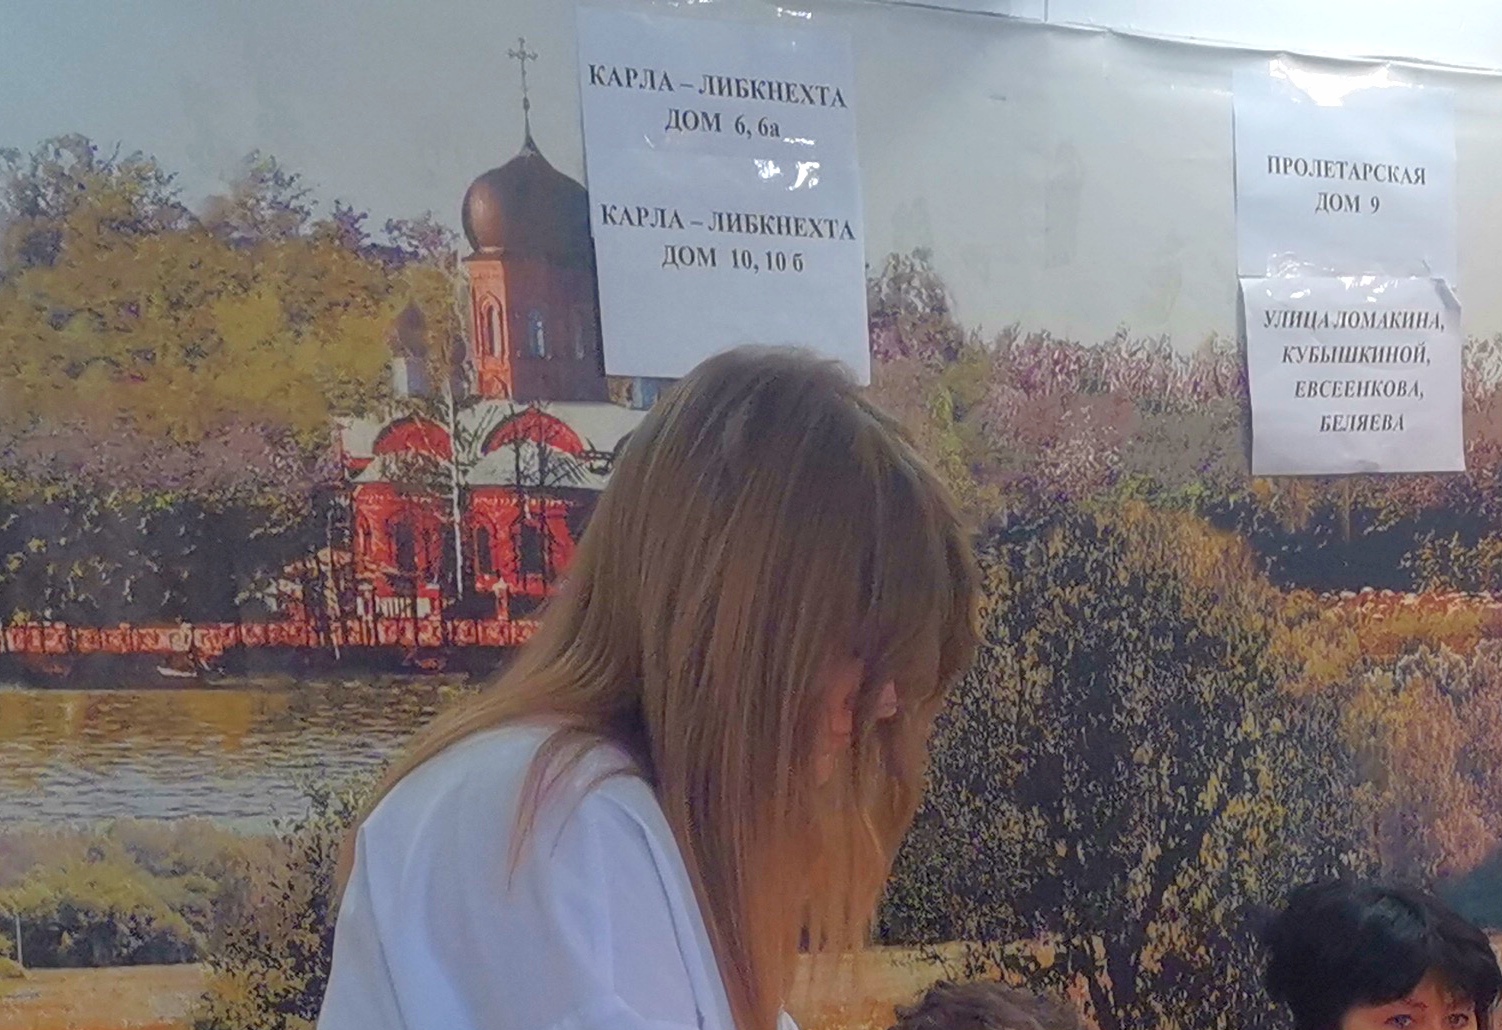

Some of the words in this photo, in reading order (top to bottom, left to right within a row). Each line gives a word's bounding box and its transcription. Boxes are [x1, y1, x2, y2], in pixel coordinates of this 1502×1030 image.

[588, 63, 675, 93] КАРЛА
[698, 74, 849, 109] ЛИБКНЕХТА
[665, 108, 722, 134] ДОМ
[734, 115, 753, 139] 6,
[757, 117, 781, 138] 6а
[1267, 155, 1426, 185] ПРОЛЕТАРСКАЯ
[1315, 191, 1361, 214] ДОМ
[1371, 195, 1381, 214] 9
[601, 203, 685, 230] КАРЛА
[708, 211, 857, 241] ЛИБКНЕХТА
[662, 244, 717, 269] ДОМ
[731, 248, 759, 274] 10,
[766, 250, 787, 272] 10
[1263, 310, 1329, 332] УЛИЦА
[1333, 310, 1445, 332] ЛОМАКИНА,
[1281, 341, 1432, 367] КУБЫШКИНОЙ,
[1294, 379, 1424, 401] ЕВСЕЕНКОВА,
[1319, 413, 1405, 433] БЕЛЯЕВА
